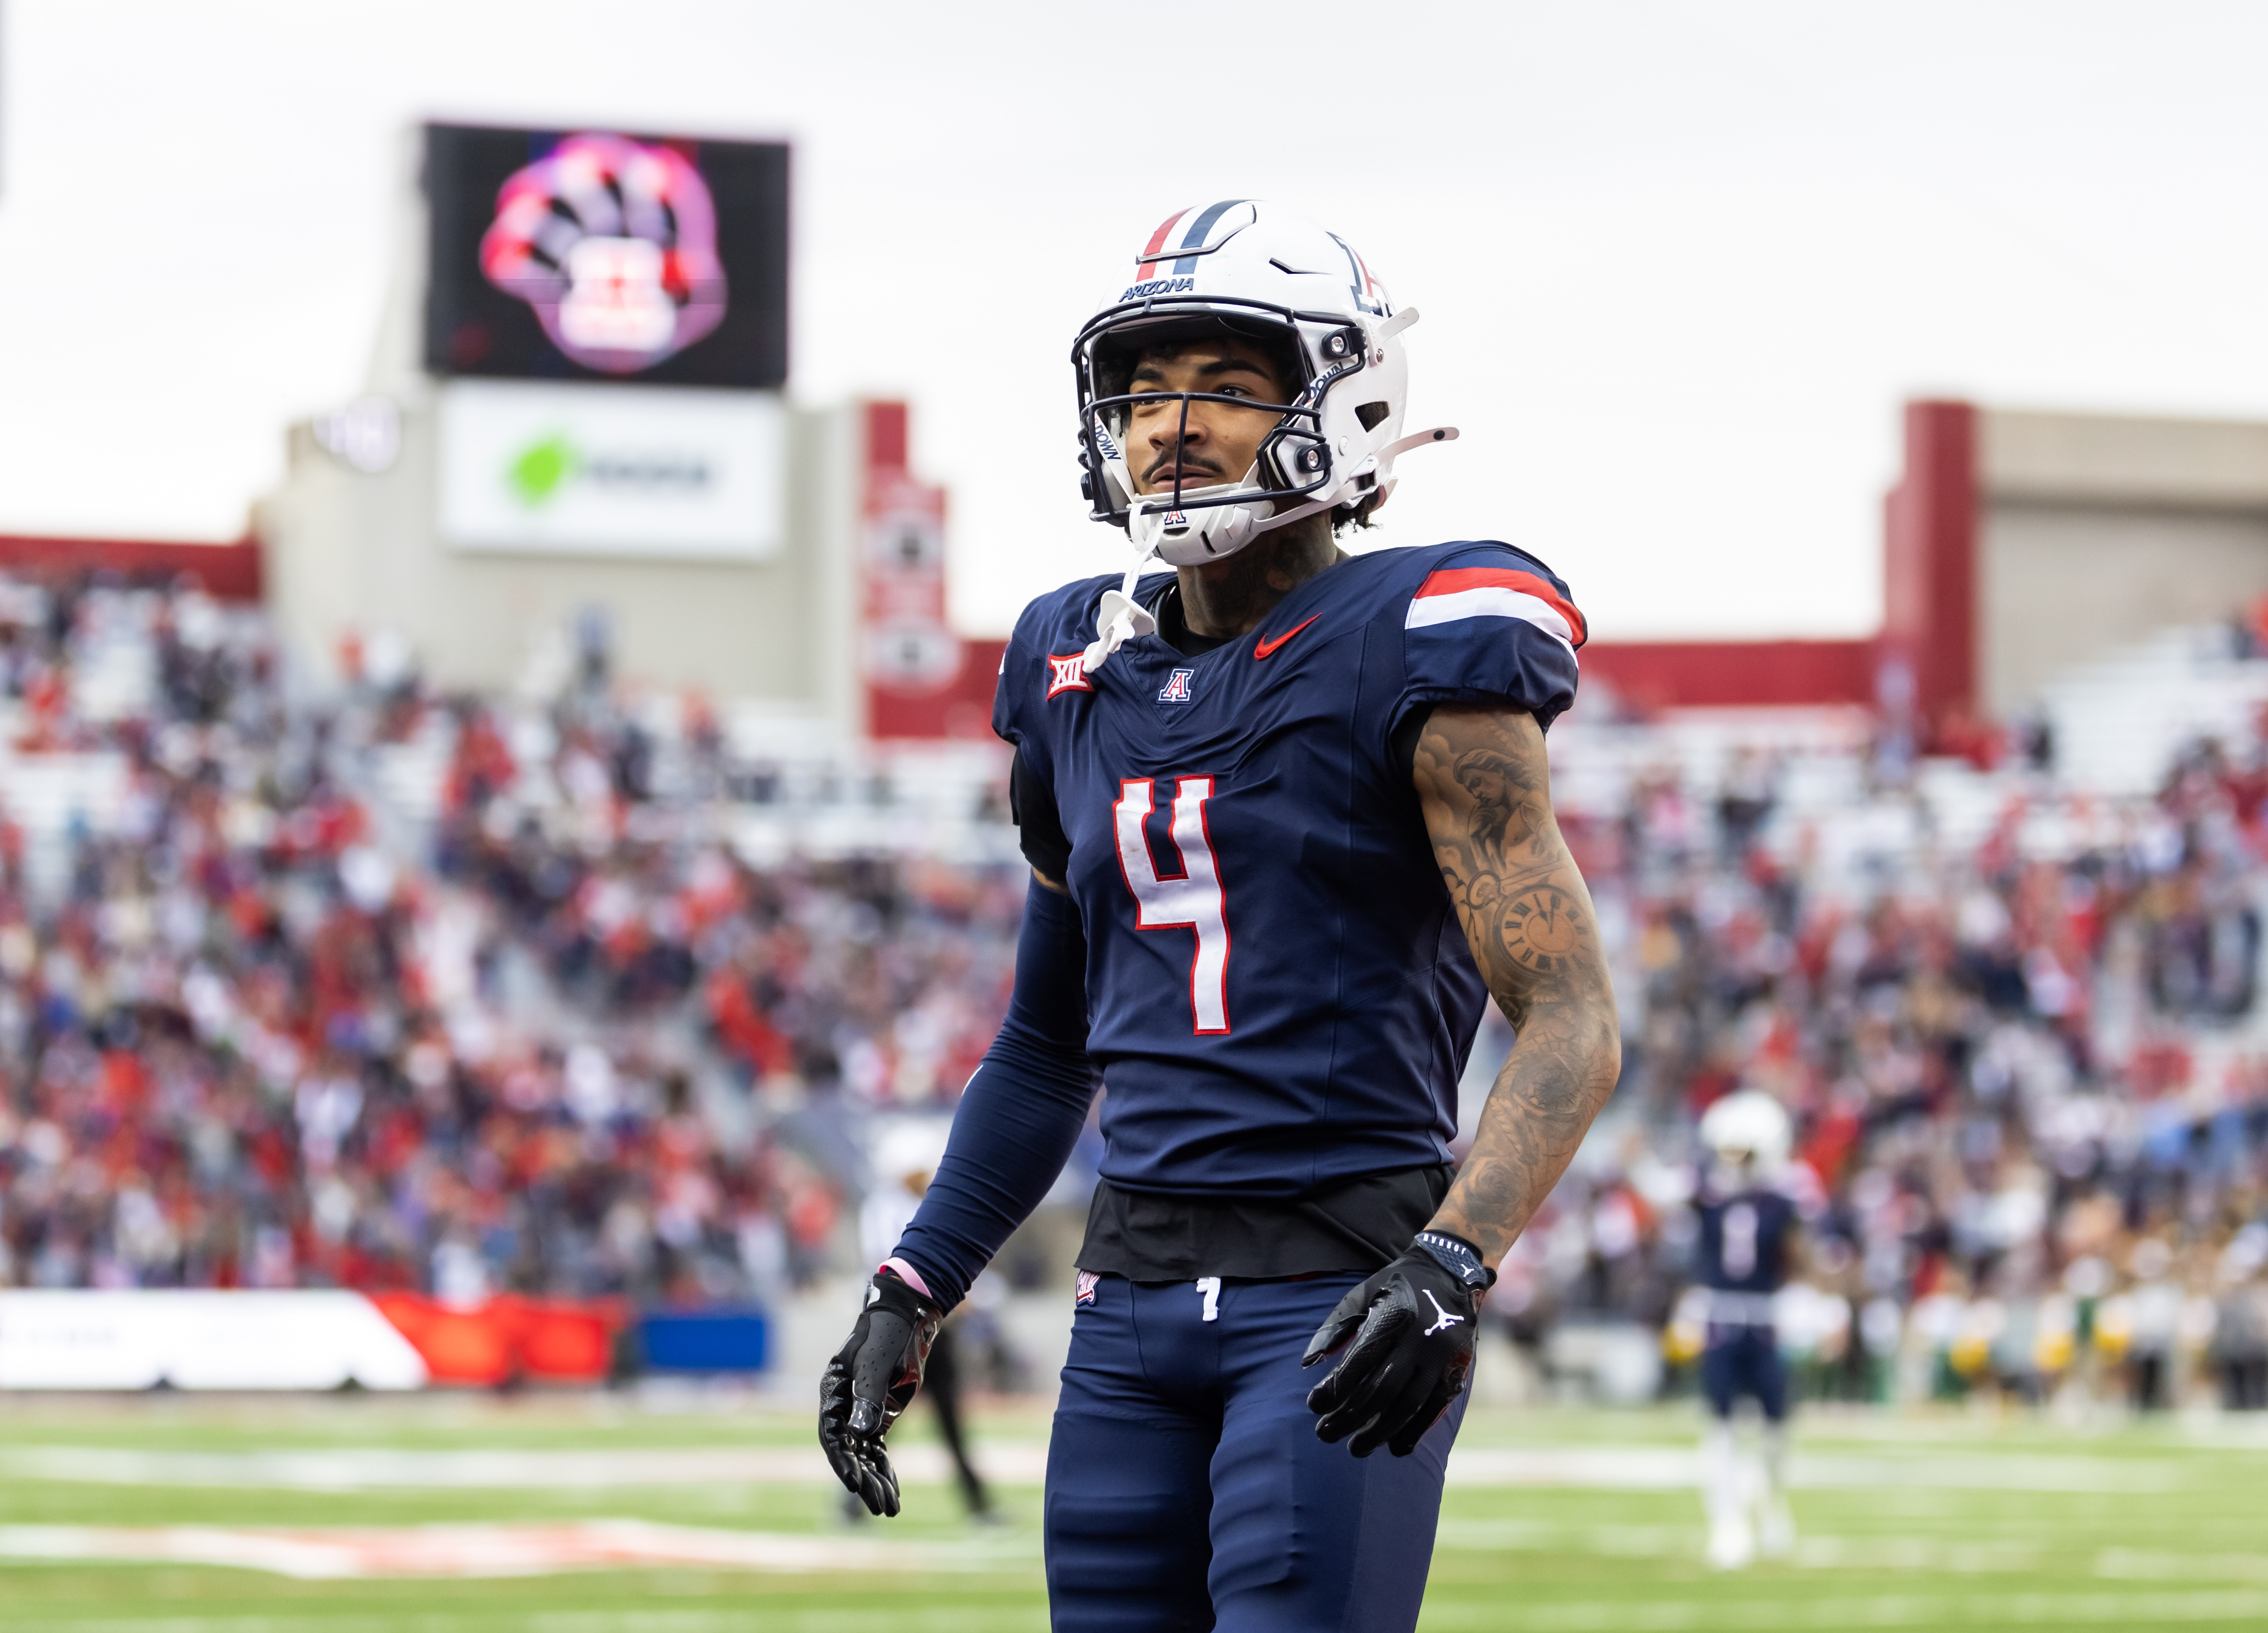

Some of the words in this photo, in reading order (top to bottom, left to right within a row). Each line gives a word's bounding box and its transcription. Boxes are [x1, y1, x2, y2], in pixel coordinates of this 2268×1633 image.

[1119, 278, 1194, 303] ARIZONA
[1095, 425, 1122, 460] DOWN
[1158, 669, 1194, 702] A
[1112, 773, 1231, 1035] 4
[1423, 1234, 1466, 1255] JORDAN
